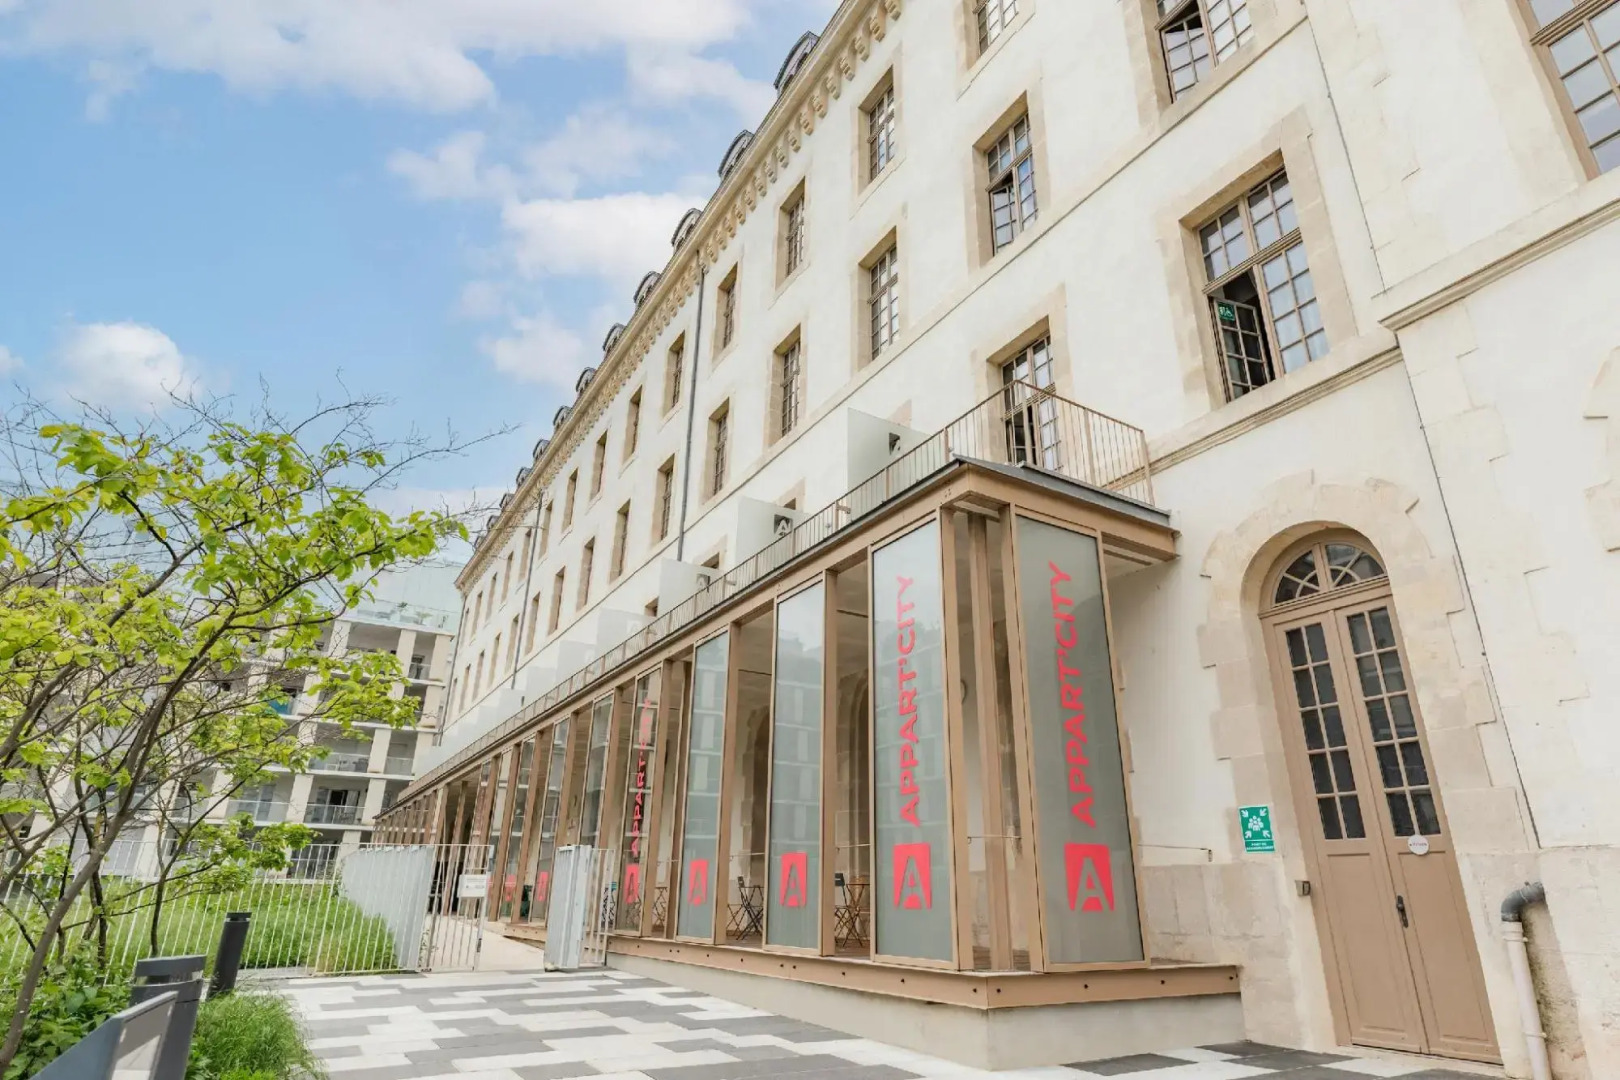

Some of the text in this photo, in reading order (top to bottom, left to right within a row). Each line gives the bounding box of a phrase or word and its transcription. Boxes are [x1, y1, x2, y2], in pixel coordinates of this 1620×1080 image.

[896, 574, 921, 828] APPART'CITY
[1049, 561, 1097, 829] APPART'CITY
[630, 697, 651, 858] APPART'
[780, 853, 807, 907] A
[894, 844, 931, 911] A
[1065, 844, 1114, 912] A
